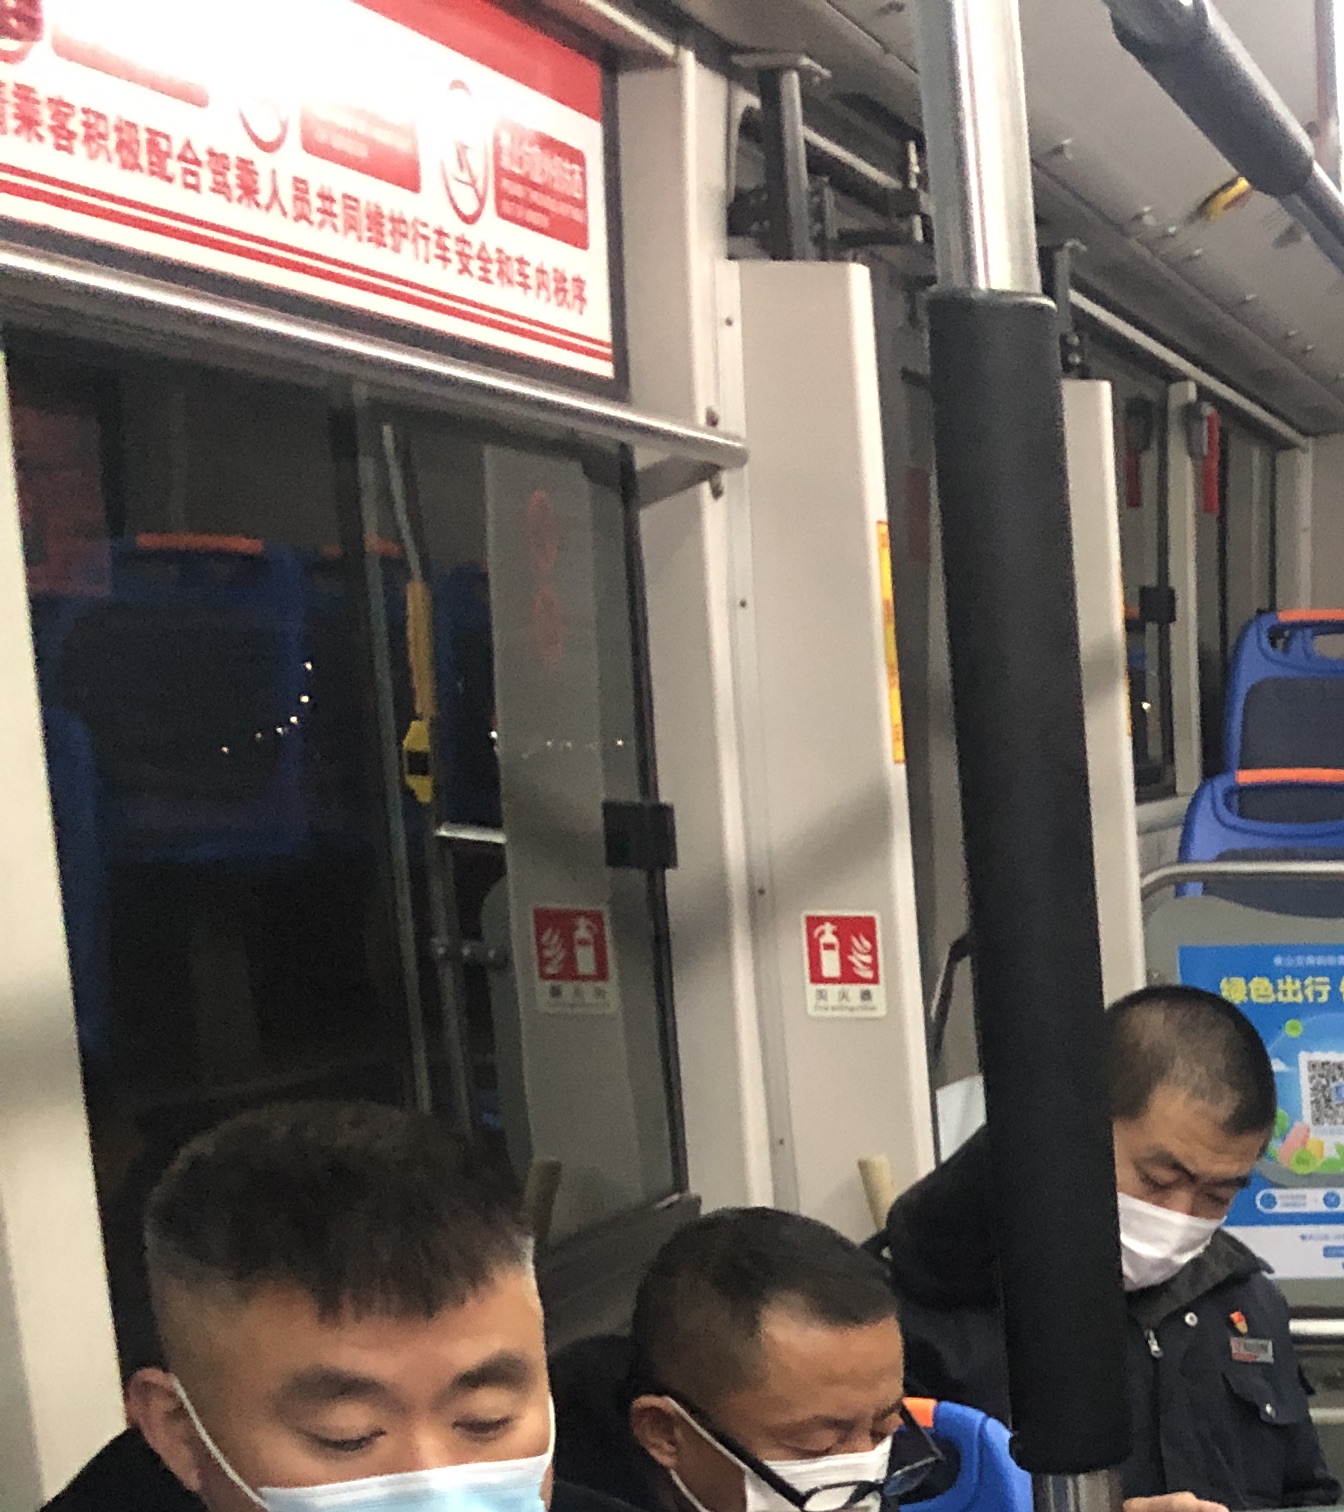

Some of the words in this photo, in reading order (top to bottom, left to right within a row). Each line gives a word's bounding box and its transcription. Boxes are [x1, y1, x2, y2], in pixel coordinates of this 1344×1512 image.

[0, 80, 588, 316] 乘客积极配合驾乘人员共同维护行车安全和车内秩序
[1219, 975, 1331, 1004] 绿色出行
